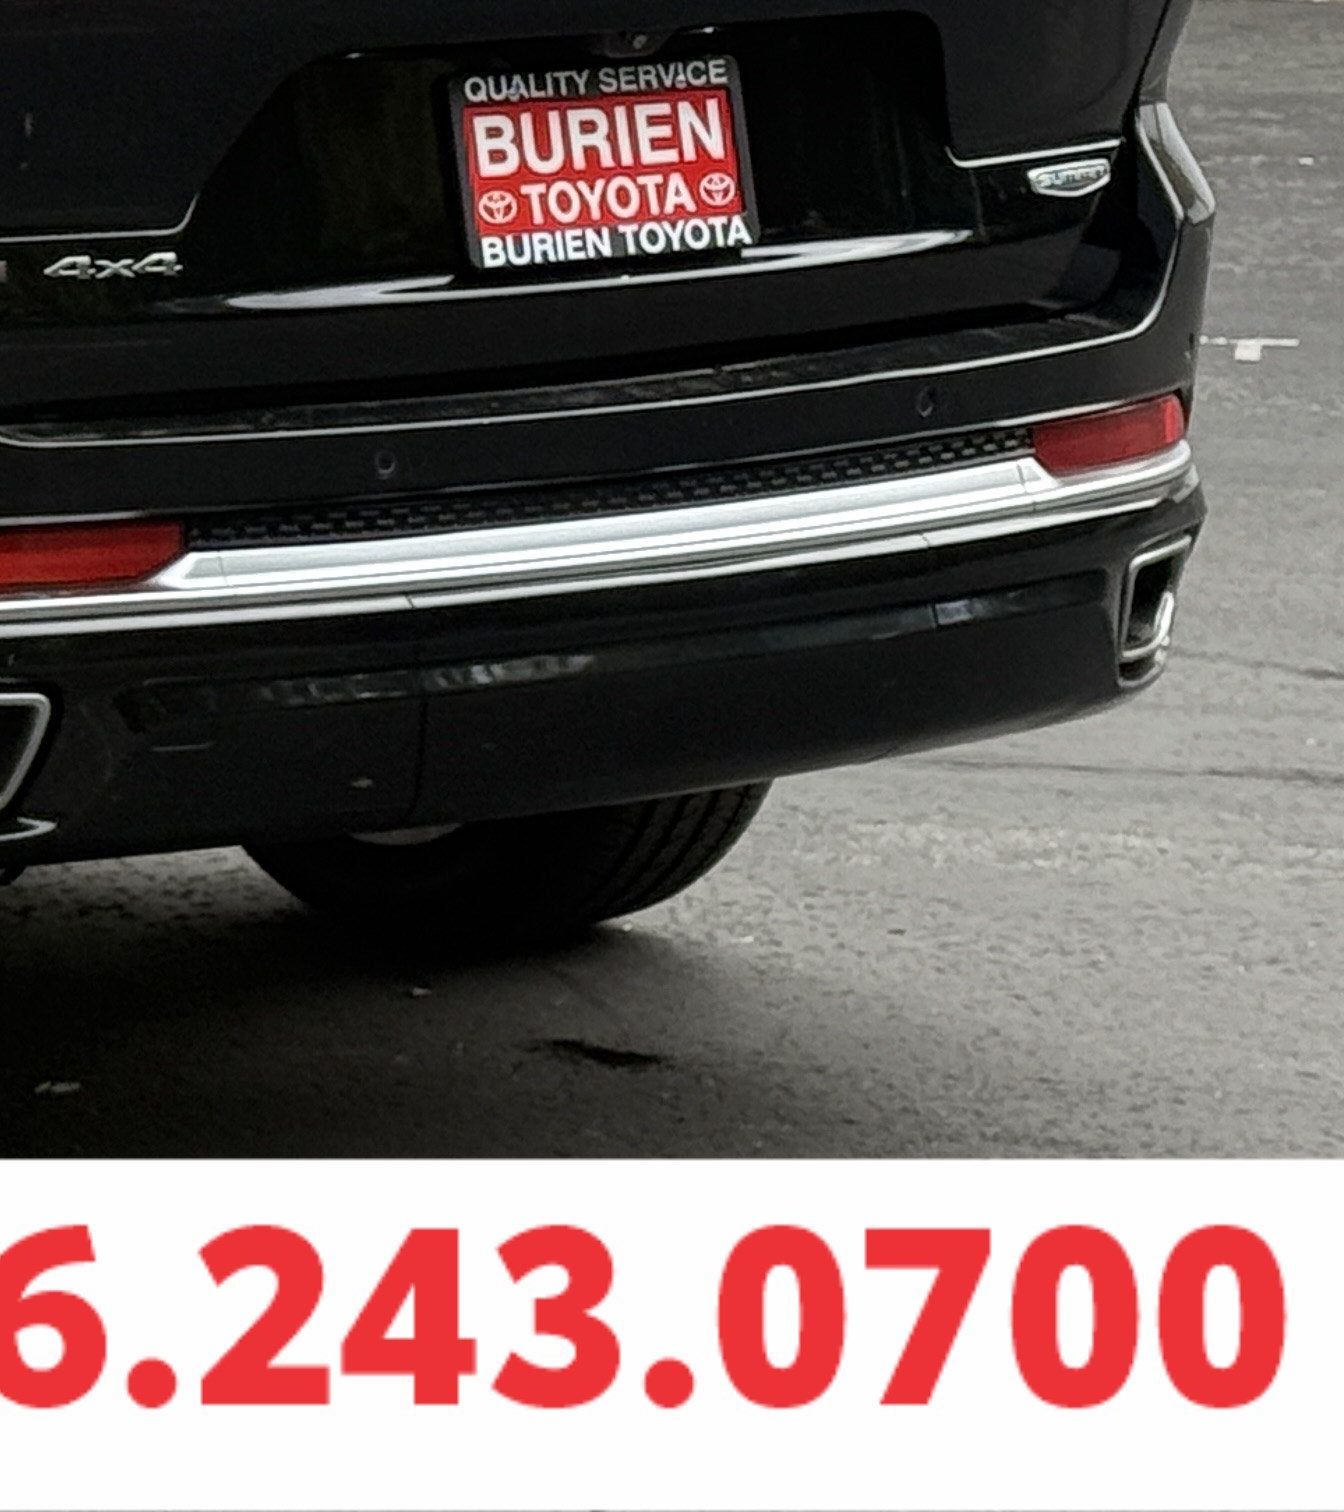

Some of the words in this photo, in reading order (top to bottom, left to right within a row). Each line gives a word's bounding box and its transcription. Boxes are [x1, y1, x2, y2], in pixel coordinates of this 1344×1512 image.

[463, 69, 591, 104] QUALITY
[599, 59, 728, 91] SERVICE
[471, 97, 726, 179] BURIEN
[519, 172, 699, 226] TOYOTA
[480, 228, 612, 269] BURIEN
[617, 215, 754, 256] TOYOTA
